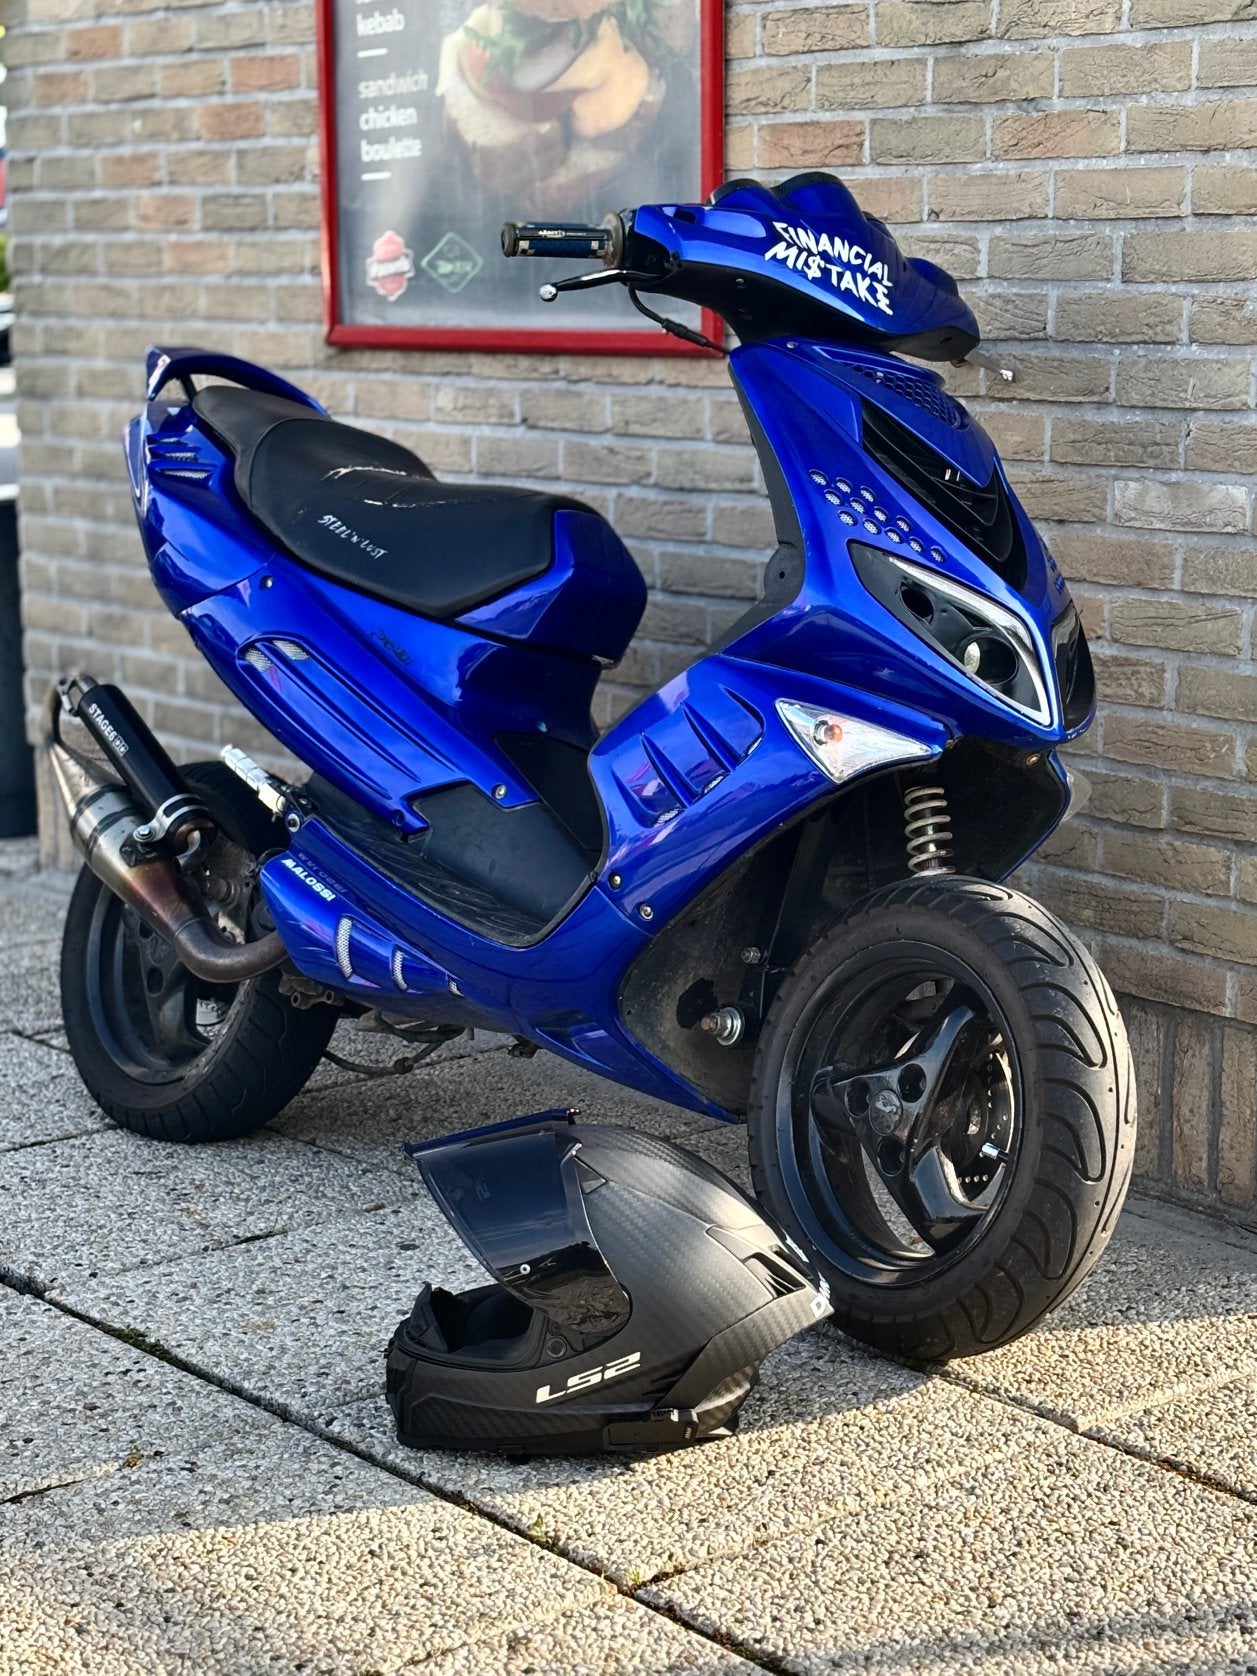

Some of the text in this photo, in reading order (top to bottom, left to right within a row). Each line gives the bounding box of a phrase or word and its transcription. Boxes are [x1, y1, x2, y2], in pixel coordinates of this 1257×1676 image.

[356, 8, 406, 36] kebab
[358, 69, 428, 99] sandwich
[359, 104, 418, 130] chicken
[360, 136, 422, 162] boulette
[772, 221, 893, 287] FINANCIAL
[764, 241, 893, 316] MI$TAKE
[89, 703, 117, 741] STAGE6
[281, 858, 336, 901] MALOSSI
[536, 1351, 641, 1403] LS2
